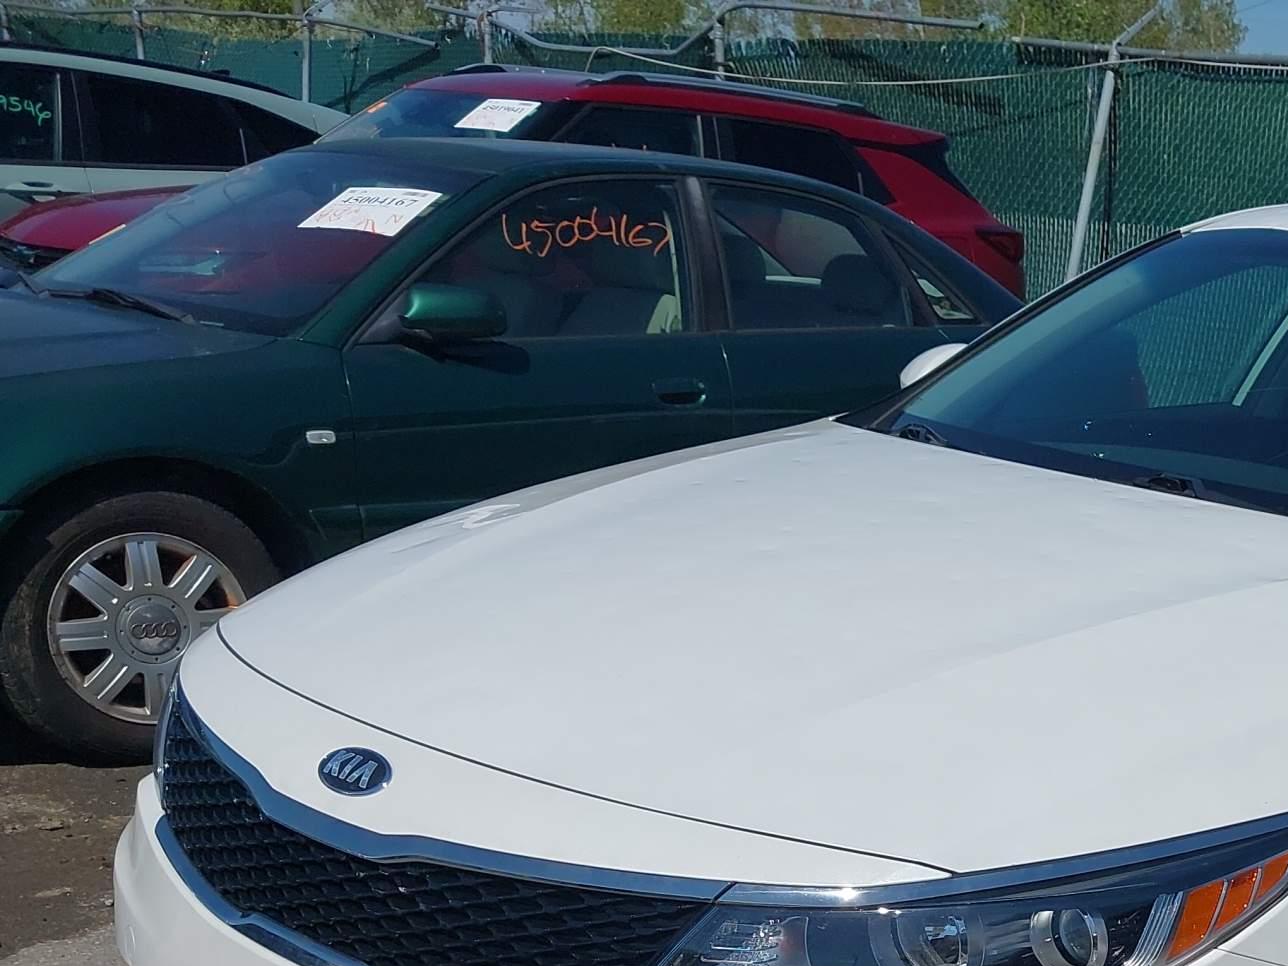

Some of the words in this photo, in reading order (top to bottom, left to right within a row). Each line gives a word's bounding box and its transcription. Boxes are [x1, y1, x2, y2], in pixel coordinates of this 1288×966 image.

[342, 195, 419, 208] 45004167
[502, 206, 671, 257] 45004167
[323, 750, 379, 789] KIA
